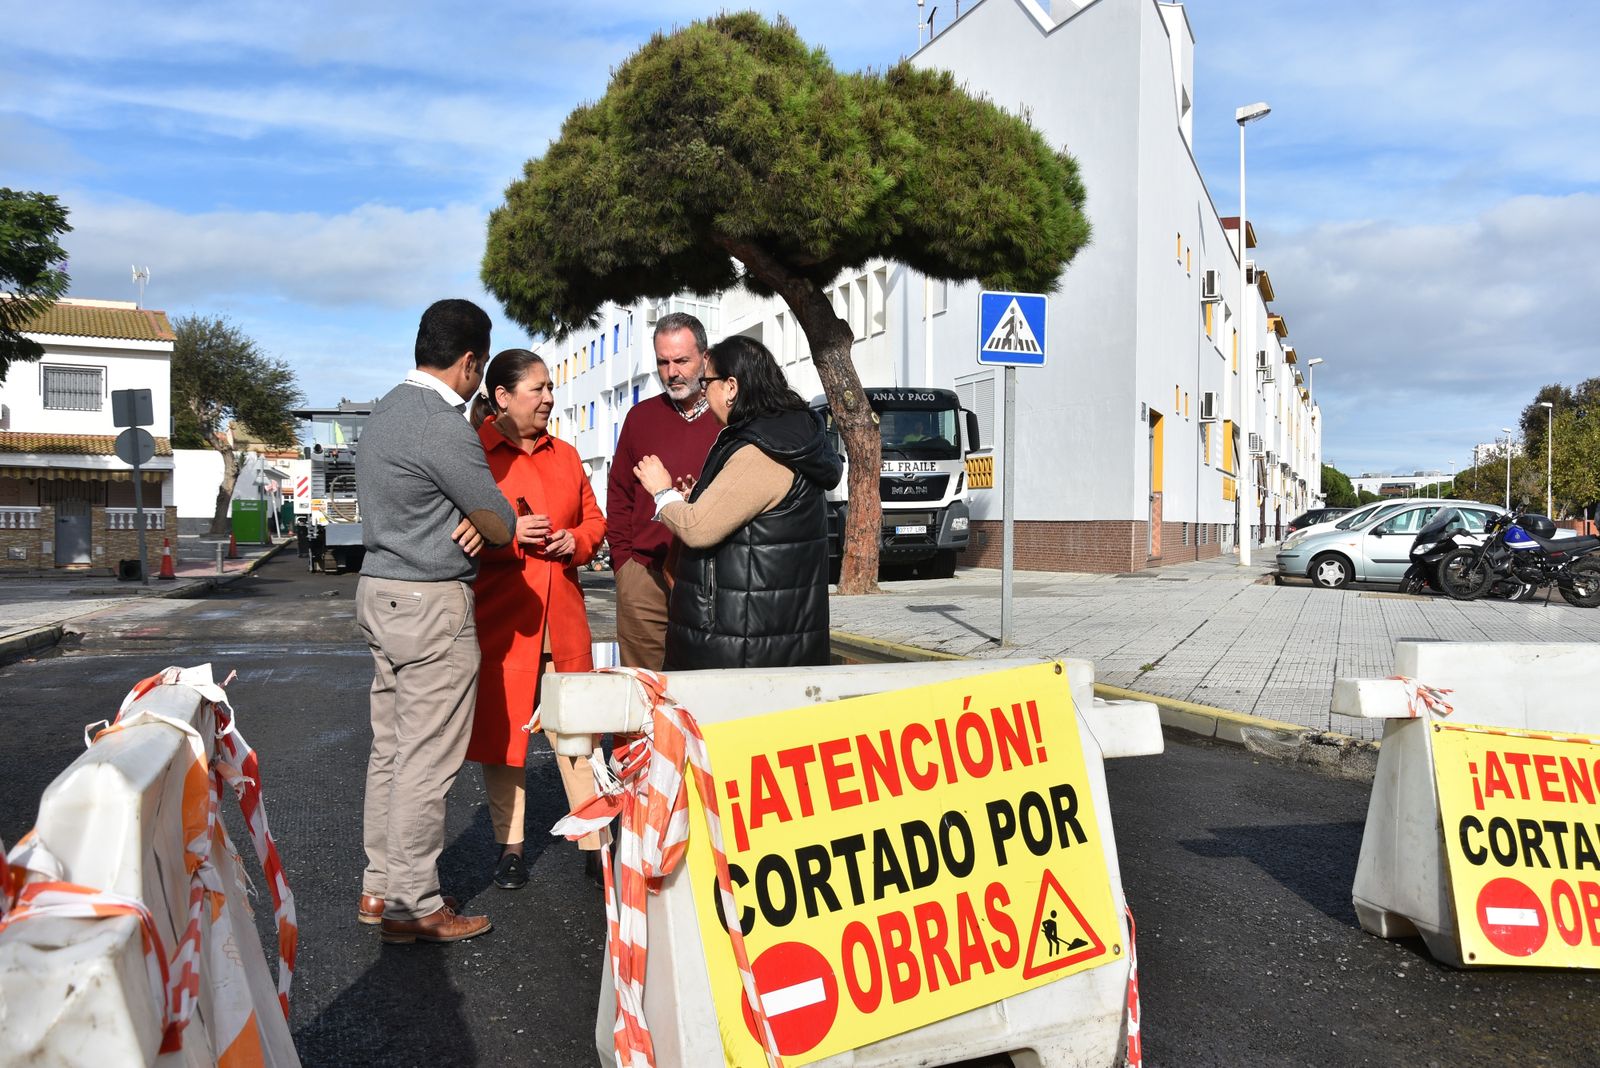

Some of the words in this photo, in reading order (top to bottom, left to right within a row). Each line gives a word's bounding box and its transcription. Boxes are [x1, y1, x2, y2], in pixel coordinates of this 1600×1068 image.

[872, 393, 896, 401] ANA
[898, 393, 905, 401] Y
[908, 393, 936, 402] PACO
[891, 486, 928, 495] MAN
[898, 462, 937, 472] FRAILE
[725, 695, 1048, 853] ¡ATENCIÓN!
[714, 810, 975, 937] CORTADO
[985, 783, 1088, 867] POR
[1459, 815, 1600, 871] CORTA
[841, 881, 1021, 1014] OBRAS
